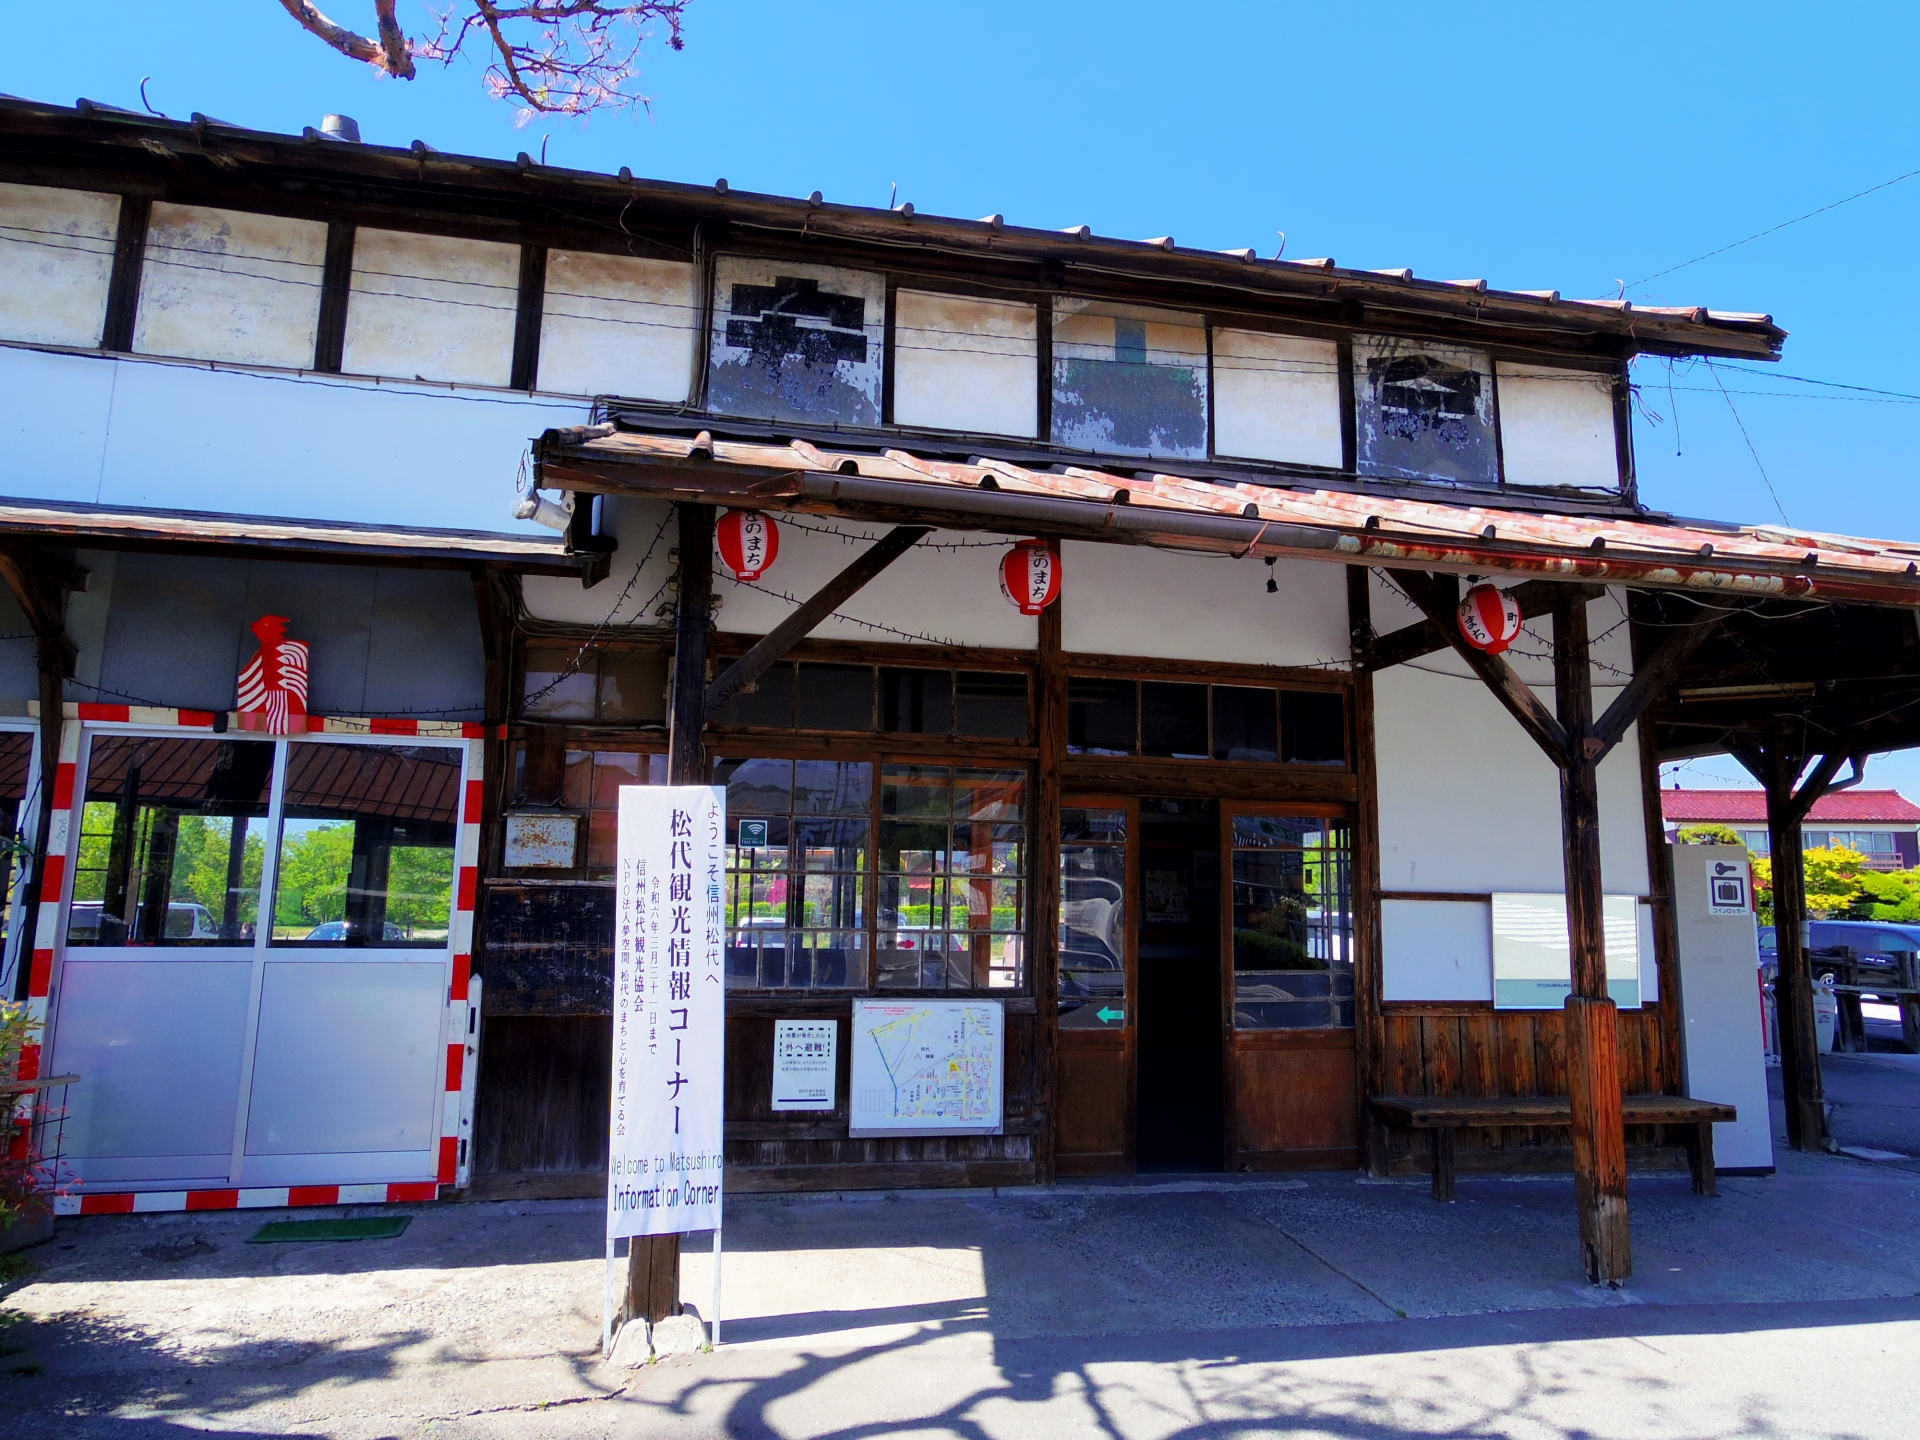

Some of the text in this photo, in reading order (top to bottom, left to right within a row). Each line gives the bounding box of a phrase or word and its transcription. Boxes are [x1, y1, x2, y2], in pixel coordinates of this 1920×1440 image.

[634, 859, 647, 1012] 信州松代観光協会
[706, 802, 719, 983] ようこそ信州松代へ
[1713, 907, 1746, 915] コインロッカー
[649, 876, 660, 1055] 令和六年三月三十一日まで
[667, 809, 692, 1134] 松代観光情報コーナー
[785, 1042, 825, 1052] 外へ避難!
[611, 1149, 722, 1175] Welcome to Matsushiro
[613, 1180, 719, 1211] Information Corner
